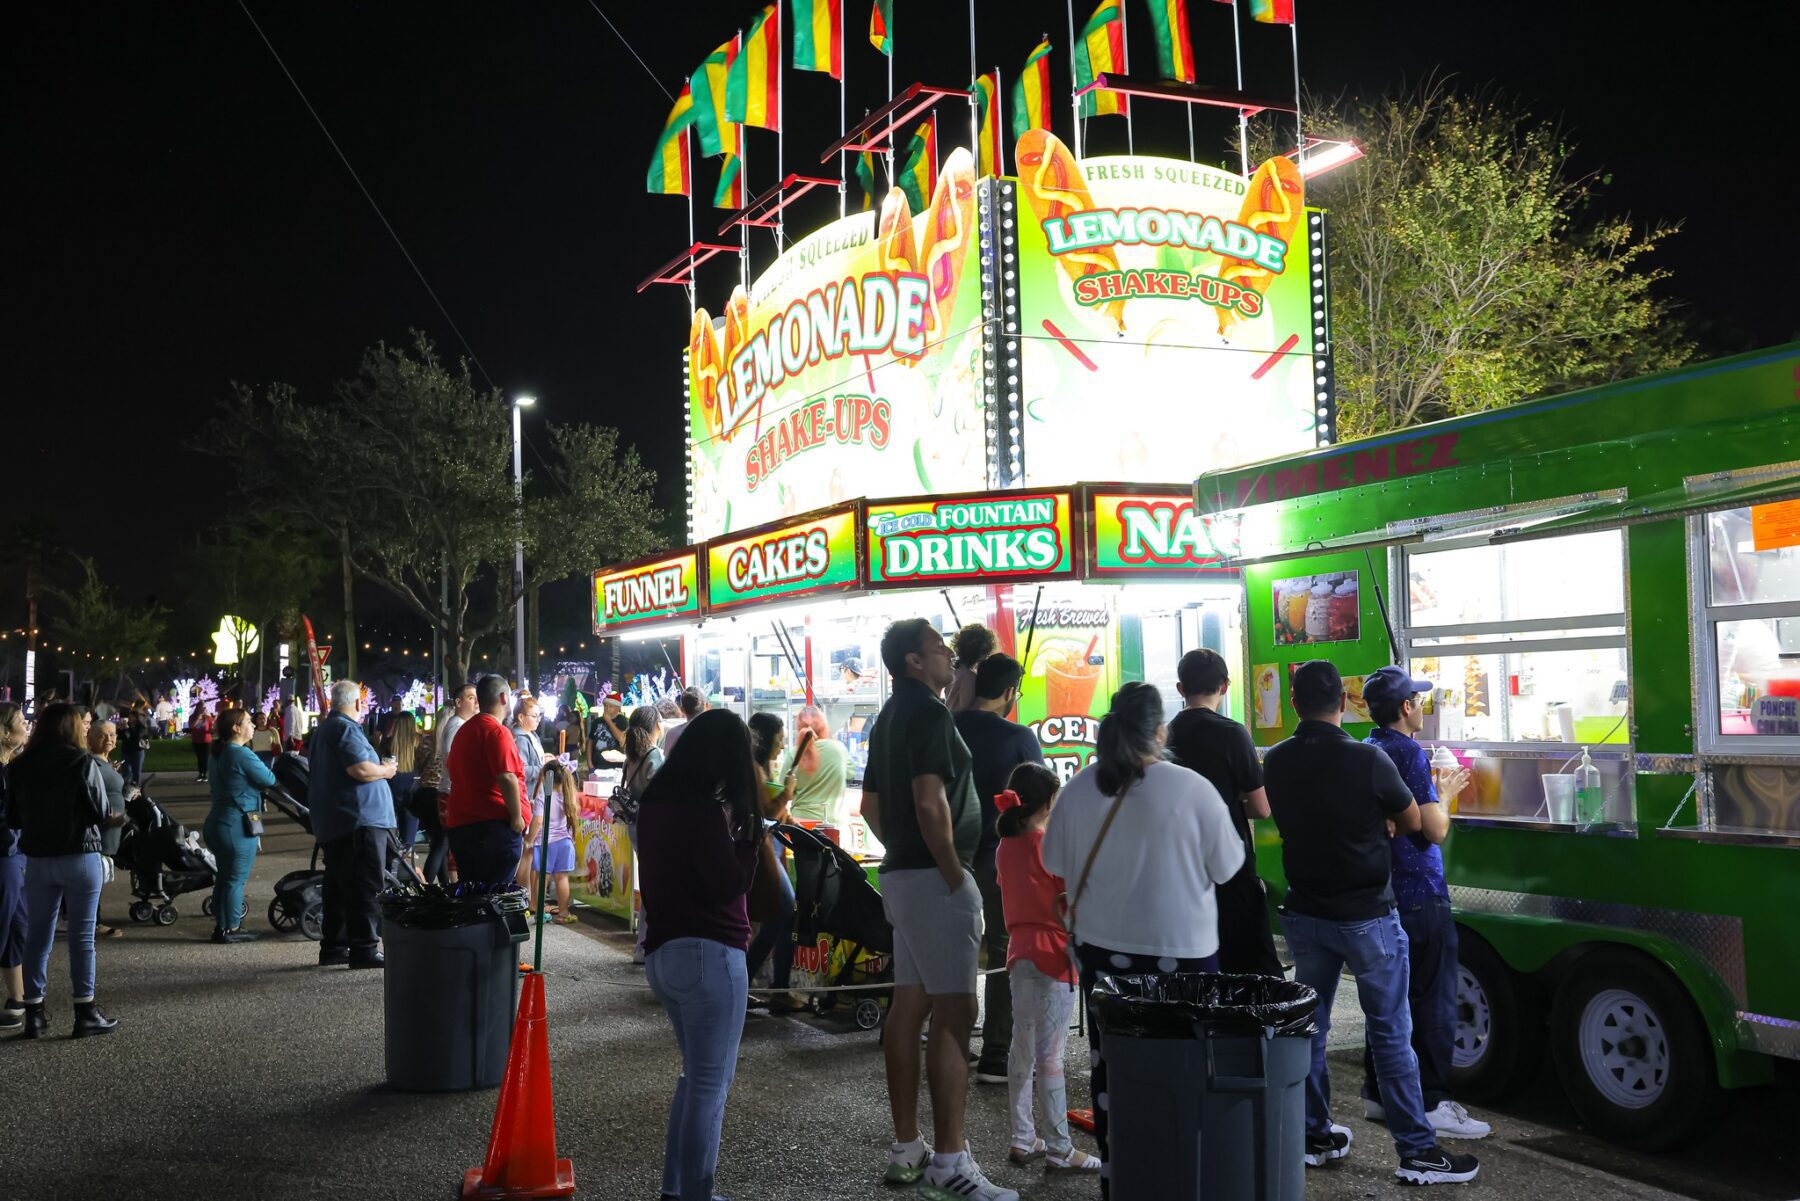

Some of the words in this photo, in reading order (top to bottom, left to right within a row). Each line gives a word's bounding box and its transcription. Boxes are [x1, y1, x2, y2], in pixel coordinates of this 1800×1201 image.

[1086, 165, 1145, 181] FRESH
[1154, 166, 1246, 196] SQUEEZED
[1043, 209, 1286, 272] LEMONADE
[1076, 271, 1262, 317] SHAKE-UPS
[717, 273, 929, 437] LEMONADE
[746, 395, 890, 491] SHAKE-UPS
[880, 519, 899, 535] ICE
[901, 514, 932, 529] COLD
[939, 501, 1051, 527] FOUNTAIN
[728, 531, 829, 590] CAKES
[887, 530, 1055, 574] DRINKS
[604, 567, 688, 616] FUNNEL
[1059, 606, 1110, 629] Brewed
[1760, 701, 1796, 716] PONCHE
